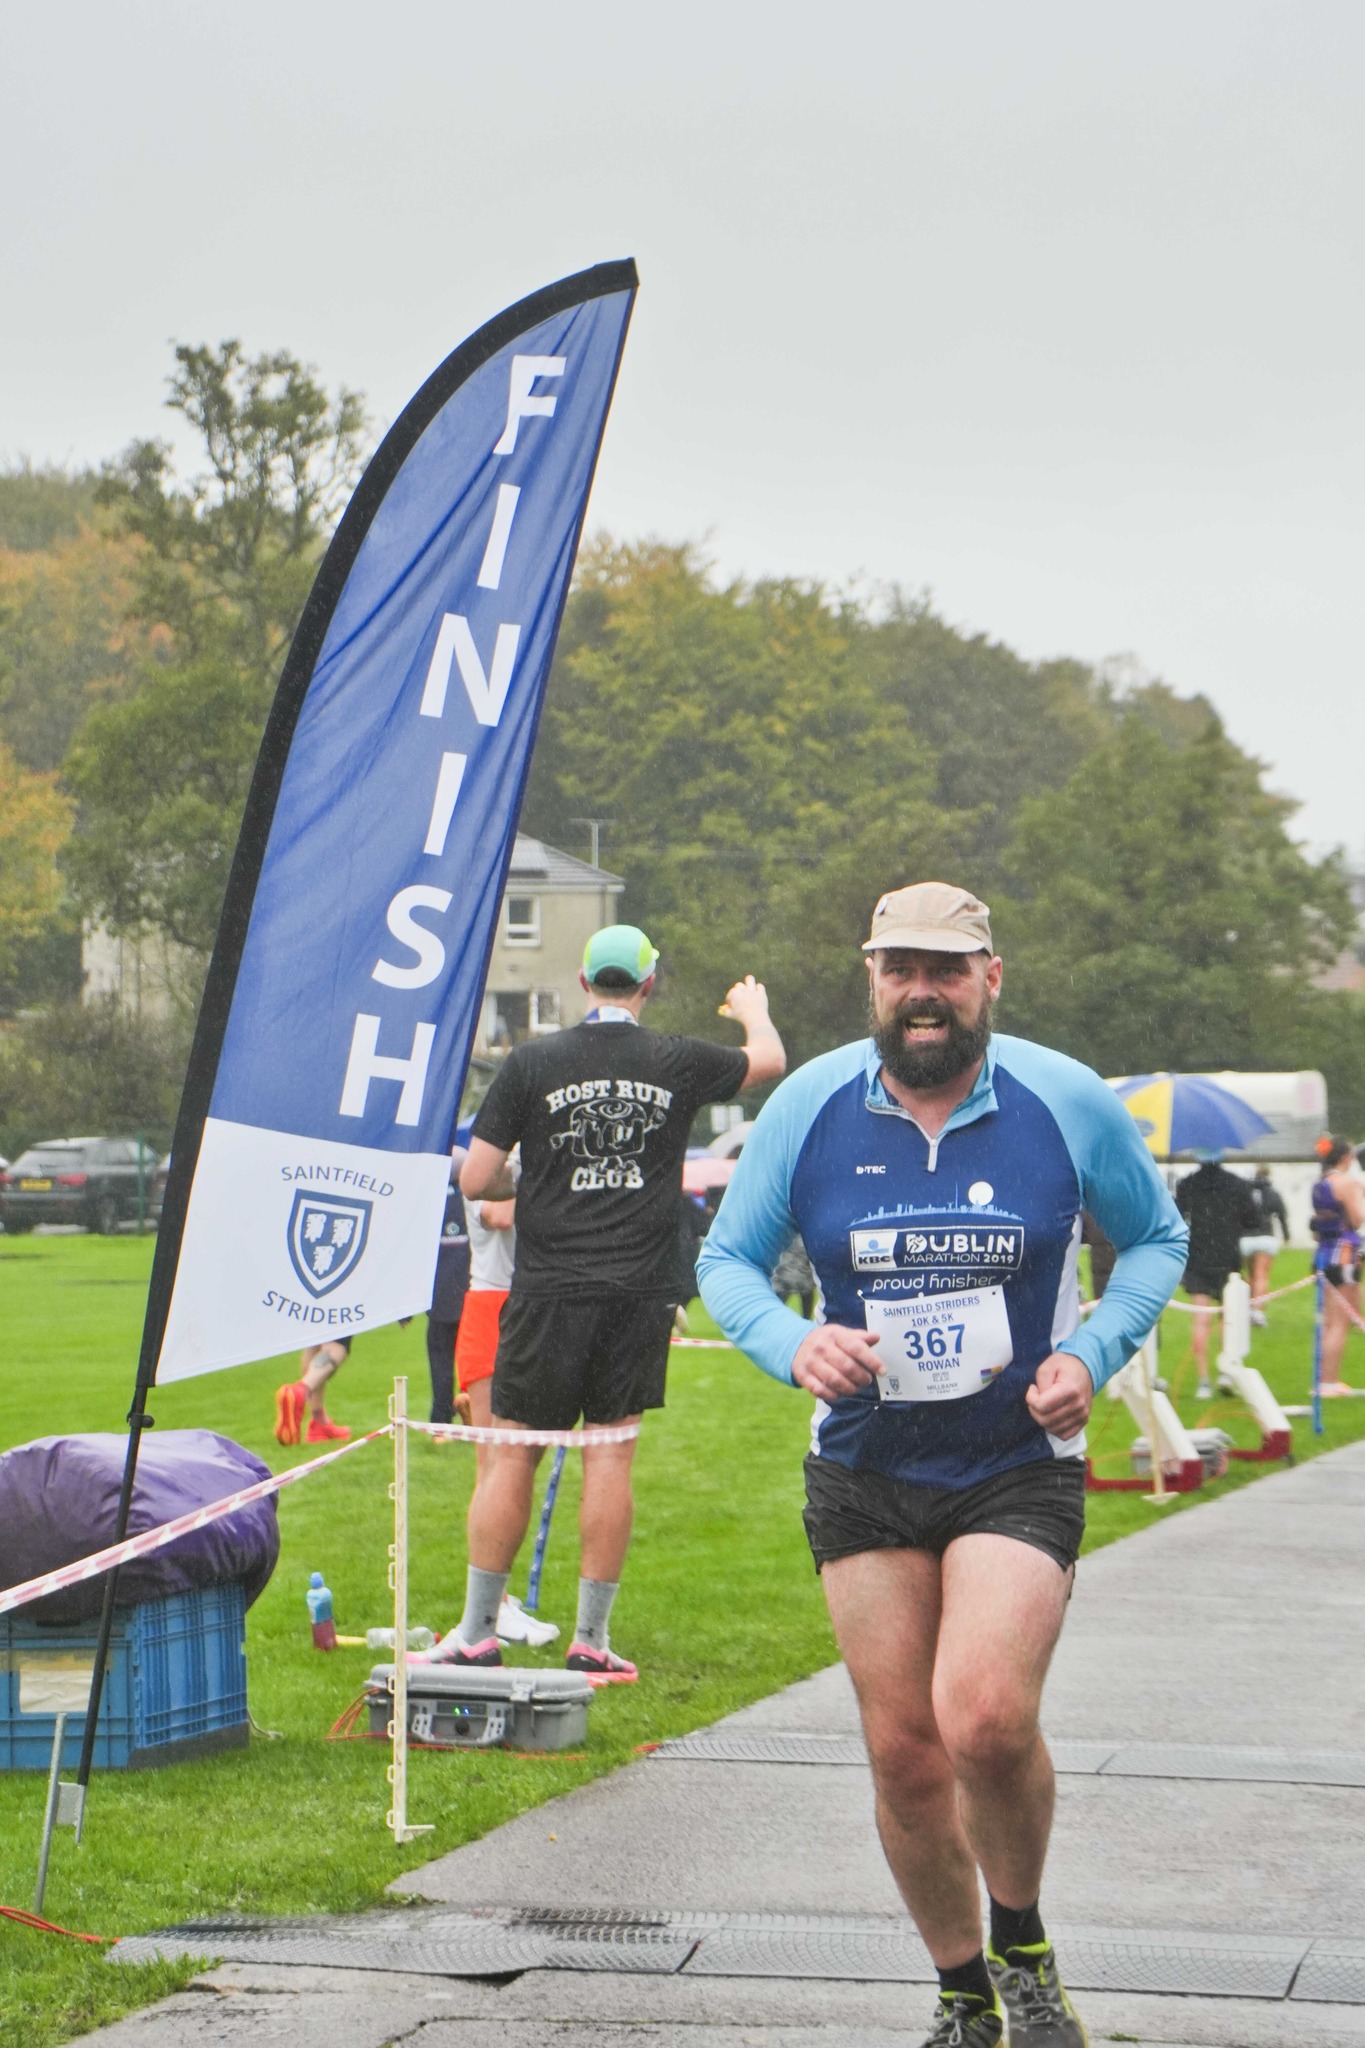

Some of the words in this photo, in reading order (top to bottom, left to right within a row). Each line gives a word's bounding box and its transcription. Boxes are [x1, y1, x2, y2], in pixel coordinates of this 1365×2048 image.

[339, 354, 567, 1127] FINISH
[546, 1080, 611, 1113] HOST
[616, 1080, 673, 1110] RUN
[281, 1165, 395, 1197] SAINTFIELD
[570, 1164, 645, 1191] CLUB
[906, 1233, 1015, 1254] DUBLIN
[858, 1255, 892, 1265] KBC
[903, 1252, 981, 1264] MARATHON
[983, 1253, 1015, 1264] 2019
[872, 1273, 925, 1293] proud
[929, 1273, 997, 1289] finisher
[262, 1290, 366, 1324] STRIDERS
[883, 1302, 933, 1317] SAINTFIELD
[935, 1295, 980, 1311] STRIDERS
[911, 1316, 930, 1328] 10K
[932, 1314, 940, 1325] &
[941, 1312, 954, 1323] 5K
[903, 1323, 966, 1360] 367
[917, 1357, 961, 1372] ROWAN
